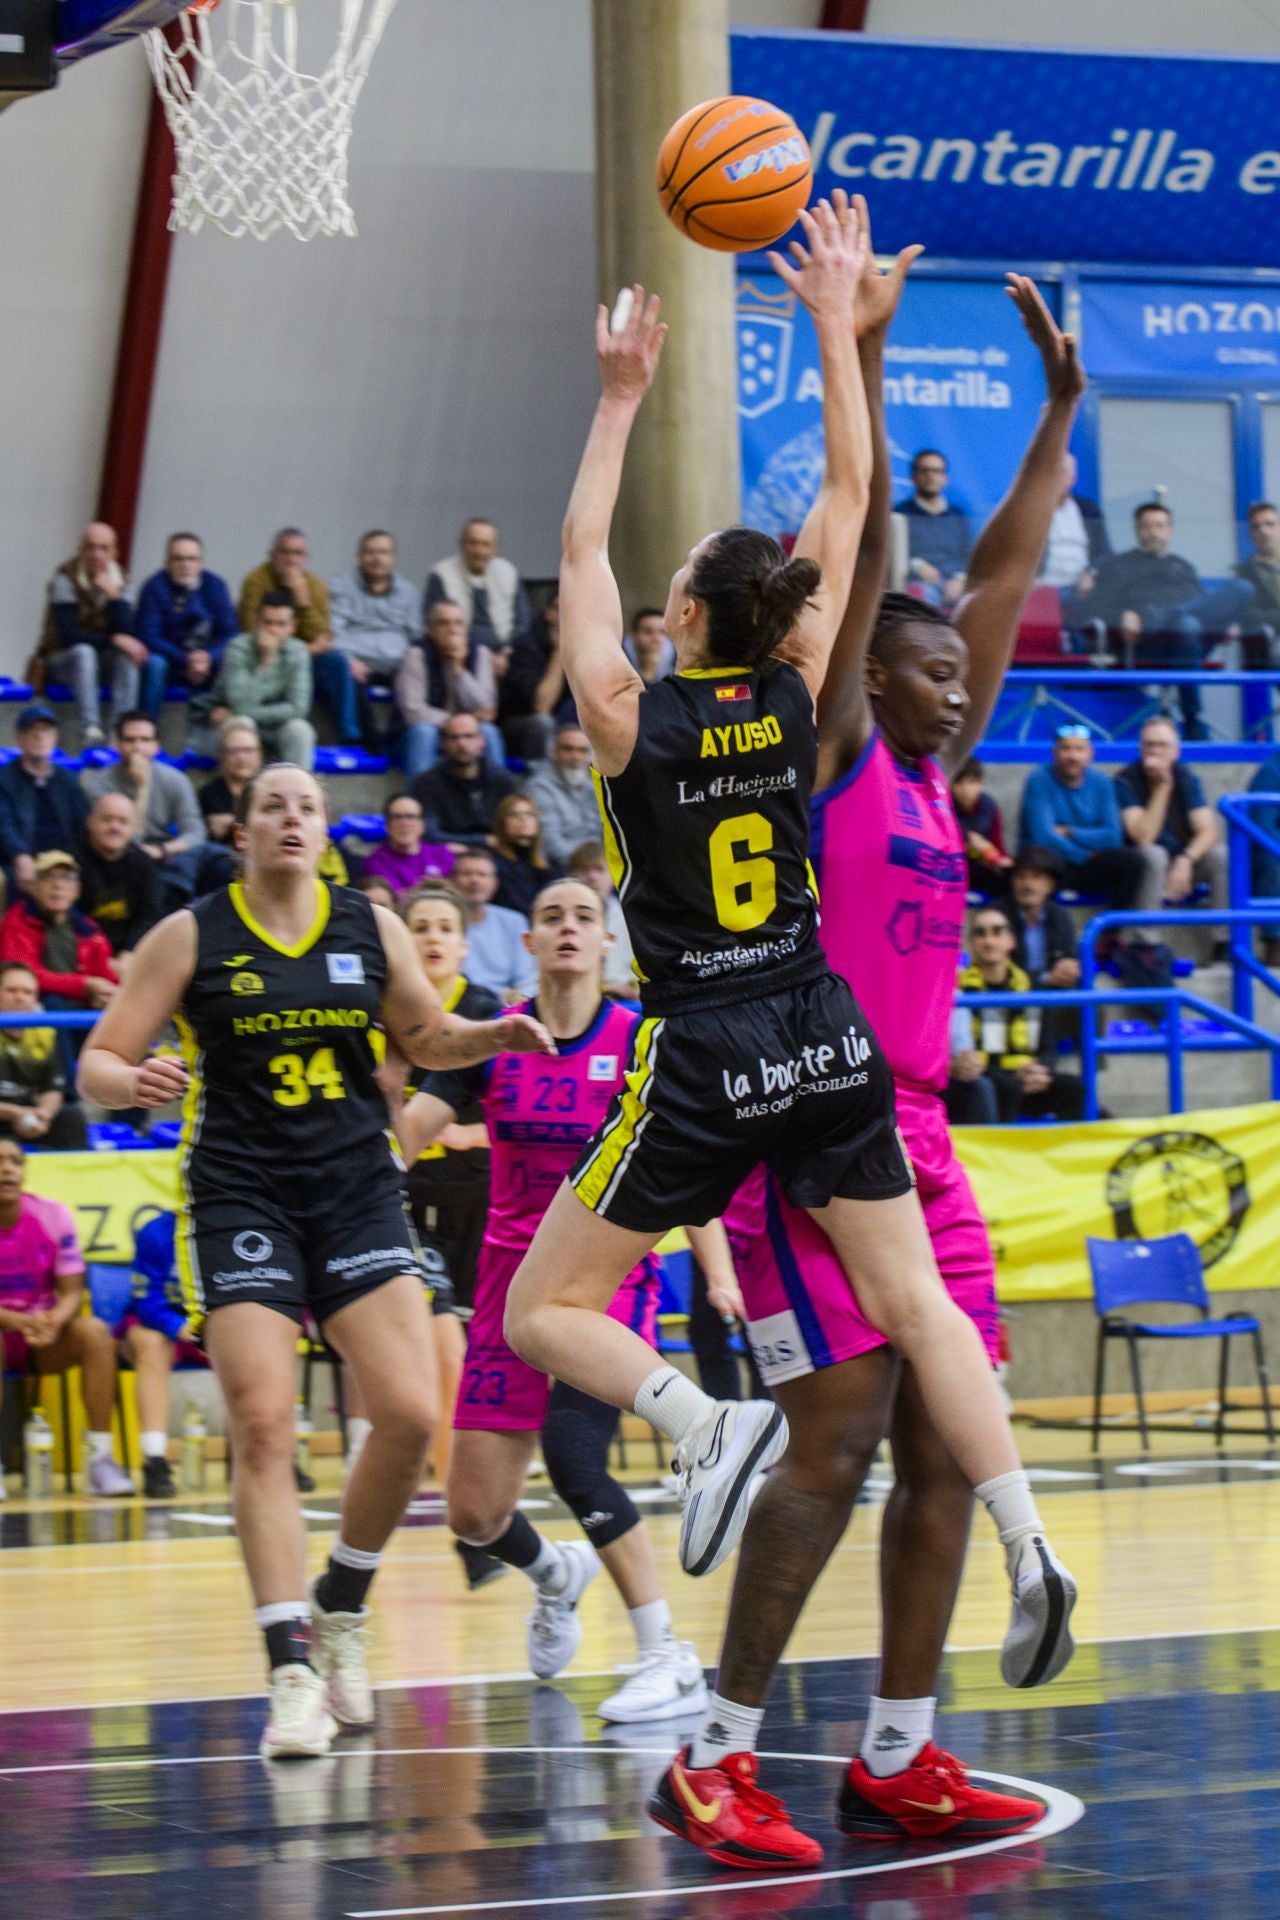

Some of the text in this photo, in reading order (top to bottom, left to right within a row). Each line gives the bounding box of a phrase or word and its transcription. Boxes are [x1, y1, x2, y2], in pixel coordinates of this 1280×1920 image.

[810, 111, 1215, 193] lcantarilla
[1143, 302, 1280, 338] HOZO
[796, 367, 1012, 409] Antarilla
[700, 715, 783, 759] AYUSO
[676, 781, 706, 805] La
[708, 811, 777, 933] 6
[267, 1046, 347, 1107] 34
[532, 1075, 578, 1113] 23
[722, 1068, 752, 1102] la
[464, 1368, 508, 1406] 23
